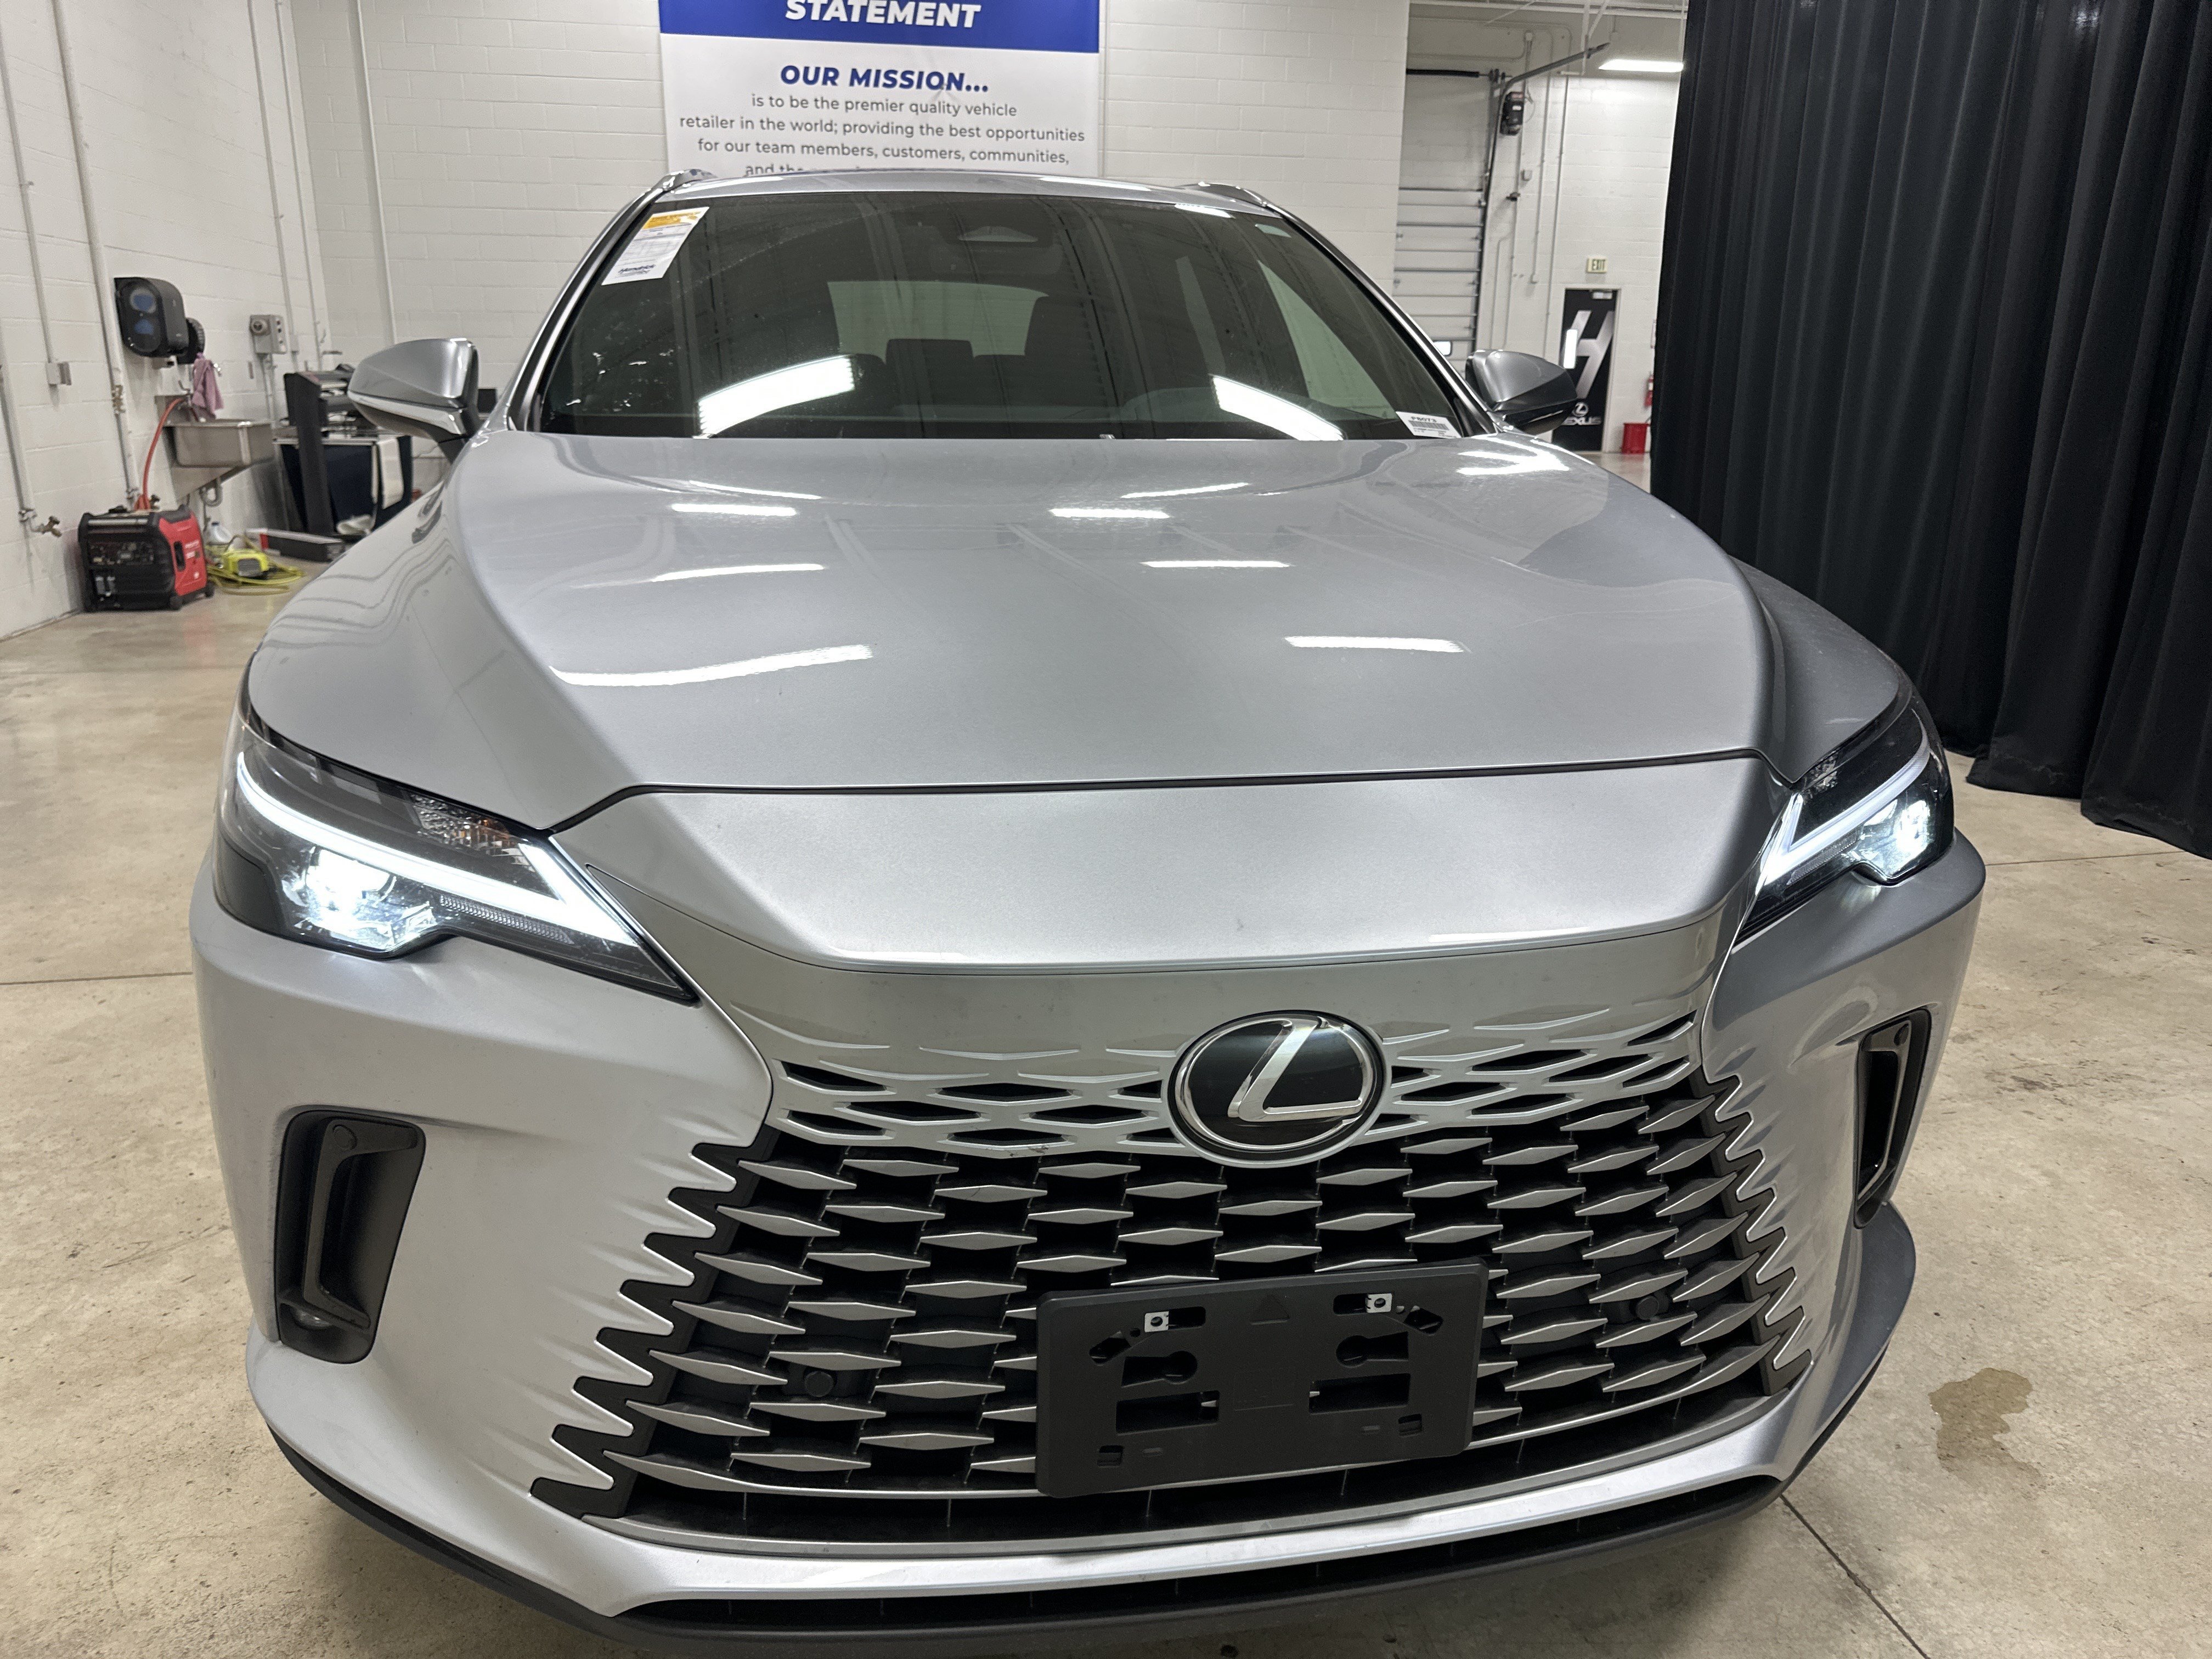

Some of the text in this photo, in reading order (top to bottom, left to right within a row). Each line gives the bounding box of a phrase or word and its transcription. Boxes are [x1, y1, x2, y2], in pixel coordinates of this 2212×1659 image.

[785, 0, 981, 28] STATEMENT
[781, 65, 989, 92] OUR MISSION...
[752, 93, 1017, 117] is to be the premier quality vehicle
[680, 115, 1085, 141] retailer in the world; providing the best opportunities
[698, 138, 1070, 165] for our team members, customers, communities,
[1592, 259, 1606, 270] EXIT
[1562, 416, 1601, 426] EXUS
